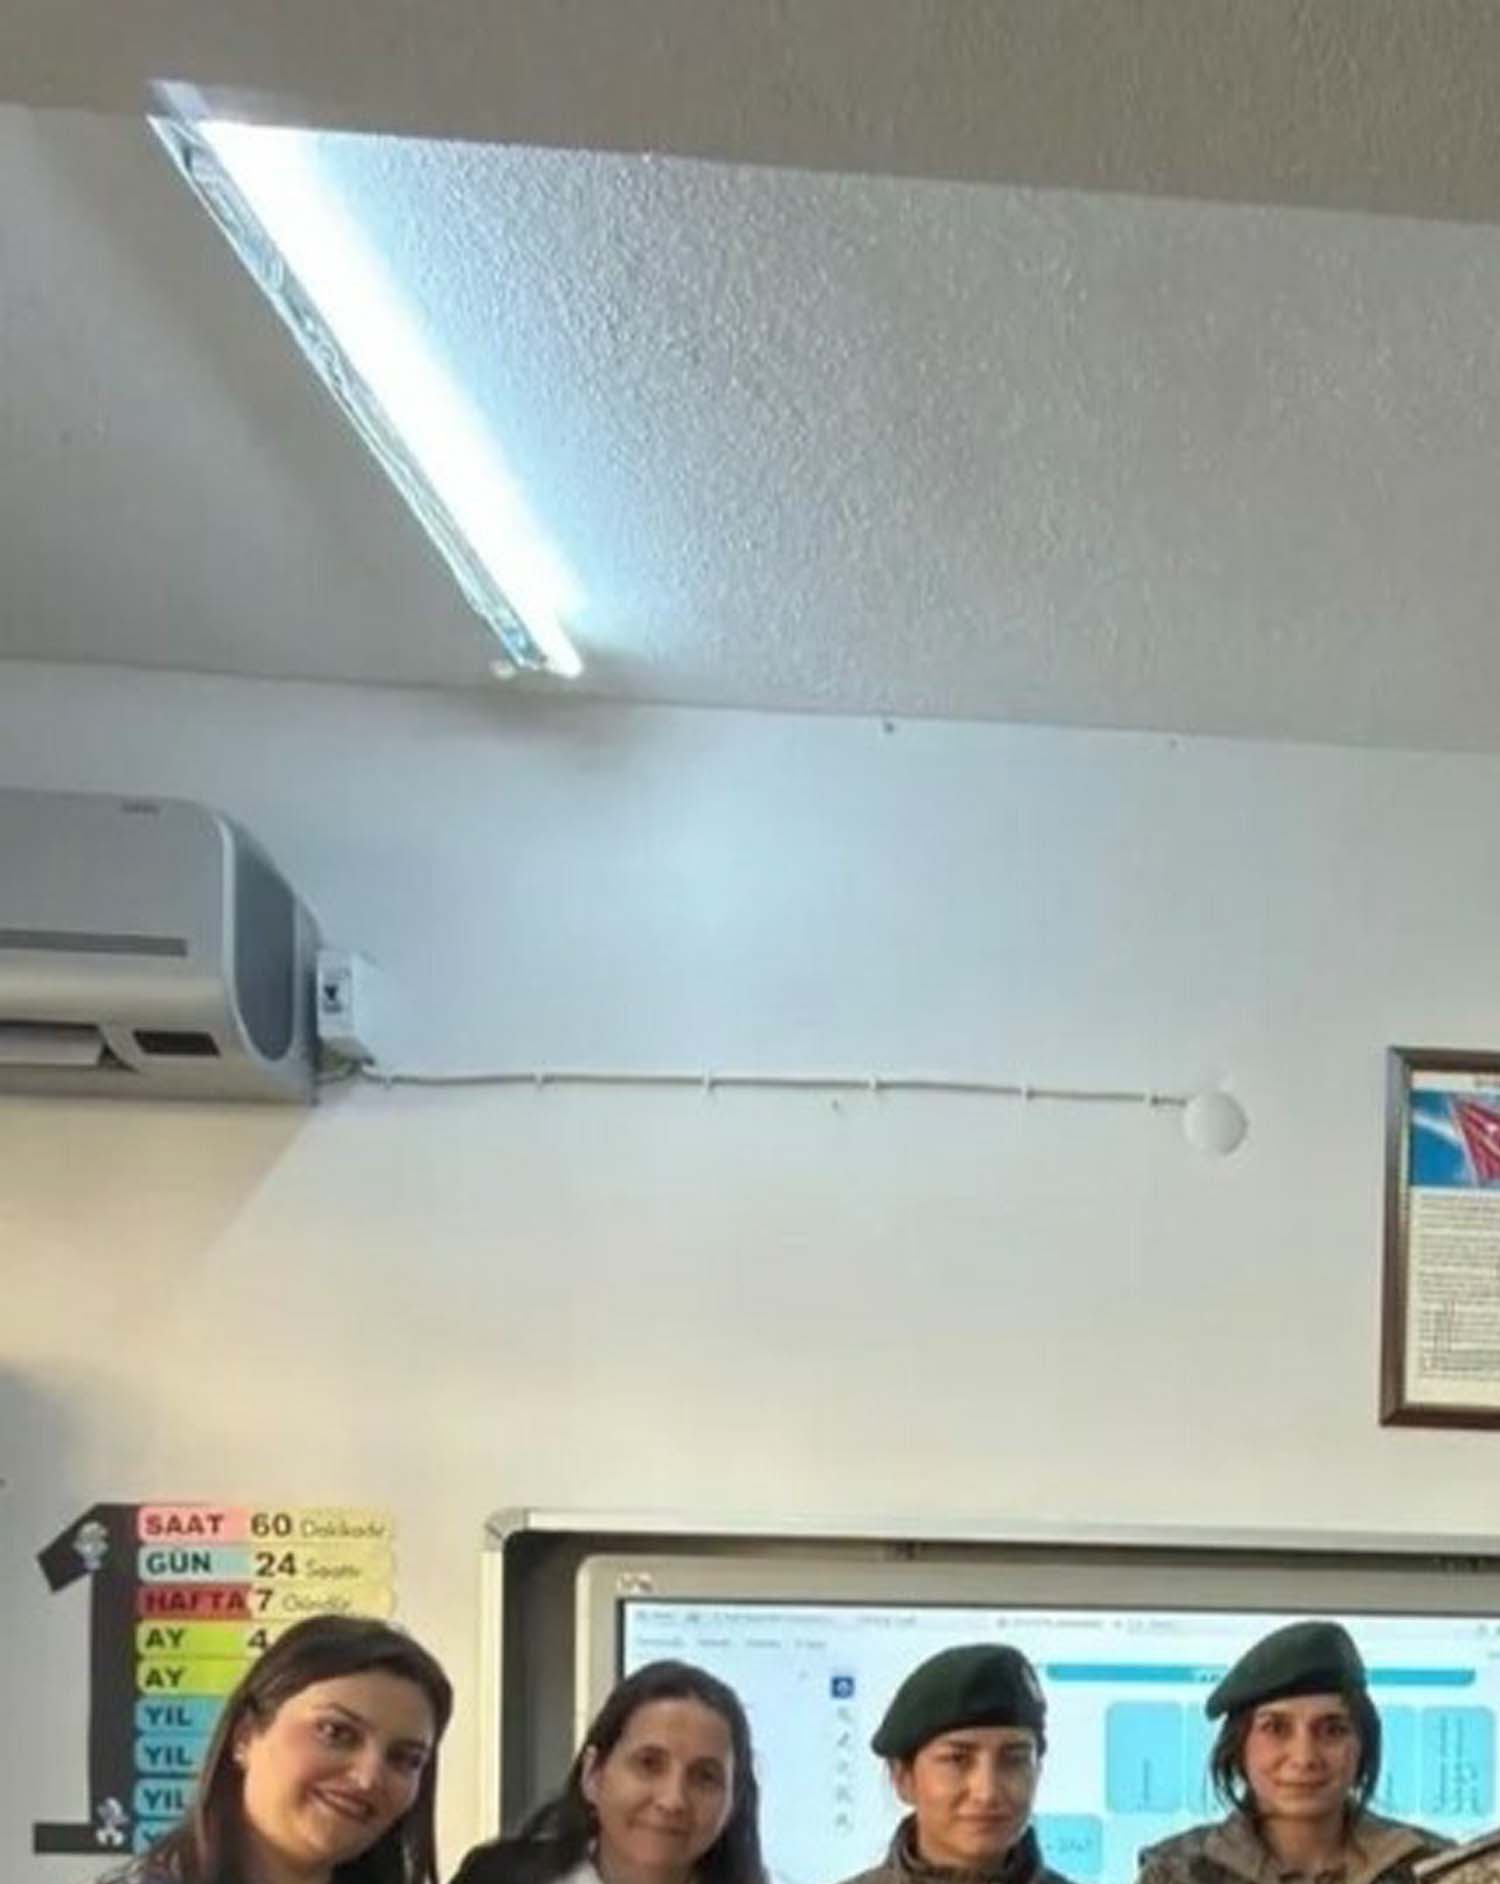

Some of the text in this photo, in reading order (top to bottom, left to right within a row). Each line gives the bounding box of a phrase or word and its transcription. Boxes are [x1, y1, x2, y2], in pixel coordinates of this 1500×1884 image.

[144, 1513, 225, 1536] SAAT
[250, 1513, 293, 1537] 60
[255, 1551, 297, 1578] 24
[145, 1590, 249, 1613] HAFTA
[255, 1588, 274, 1611] 7
[145, 1628, 268, 1649] AY 4
[145, 1667, 185, 1688] AY
[144, 1705, 193, 1727] YIL
[144, 1746, 193, 1766] YIL
